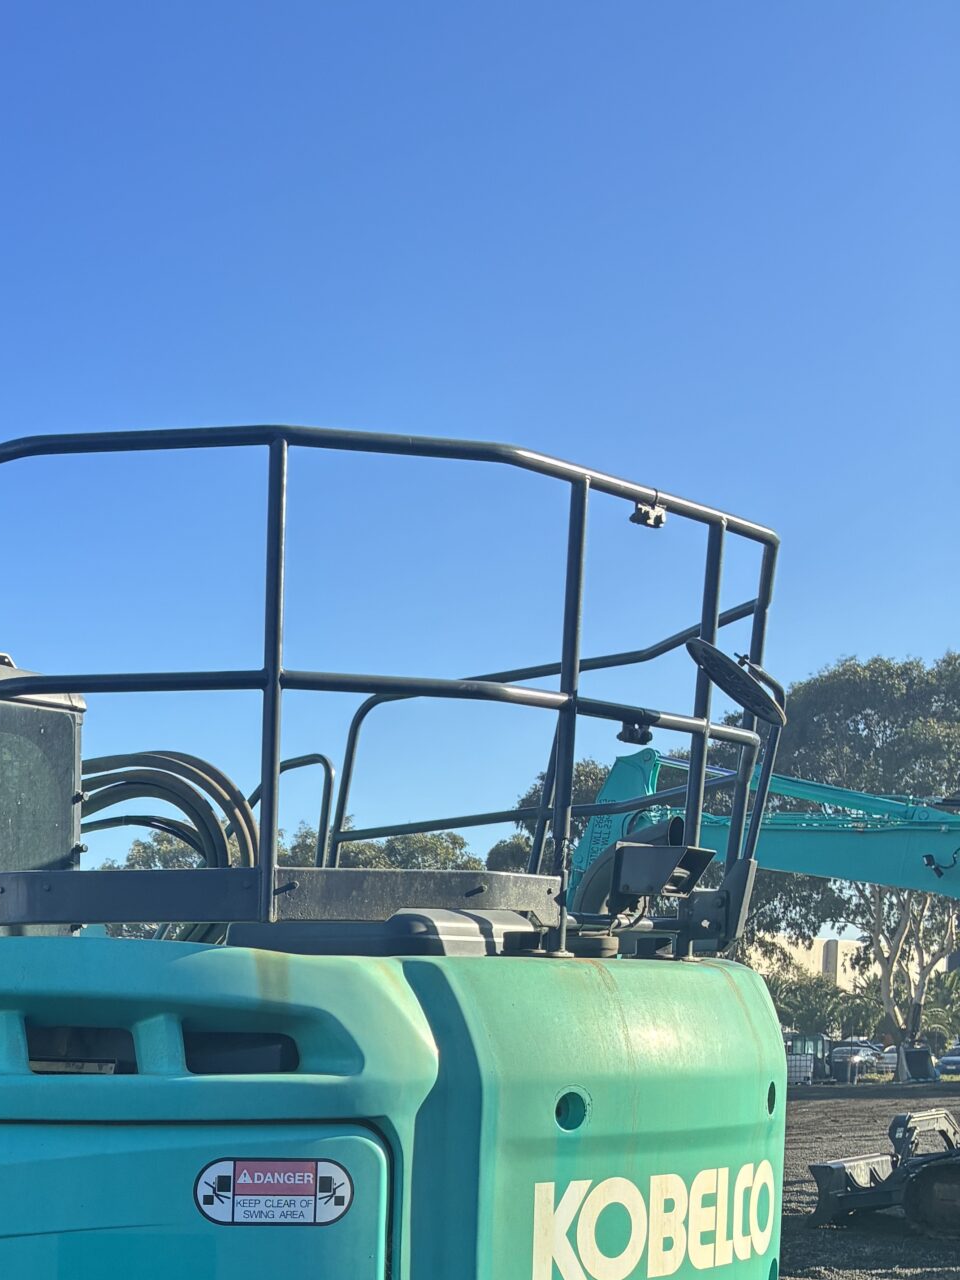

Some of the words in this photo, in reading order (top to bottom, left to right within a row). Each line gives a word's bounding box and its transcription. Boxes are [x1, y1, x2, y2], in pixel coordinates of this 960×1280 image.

[253, 1172, 314, 1184] DANGER
[236, 1199, 261, 1208] KEEP
[264, 1199, 296, 1208] CLEAR
[300, 1199, 313, 1208] OF
[243, 1210, 275, 1219] SWING
[279, 1210, 305, 1219] AREA
